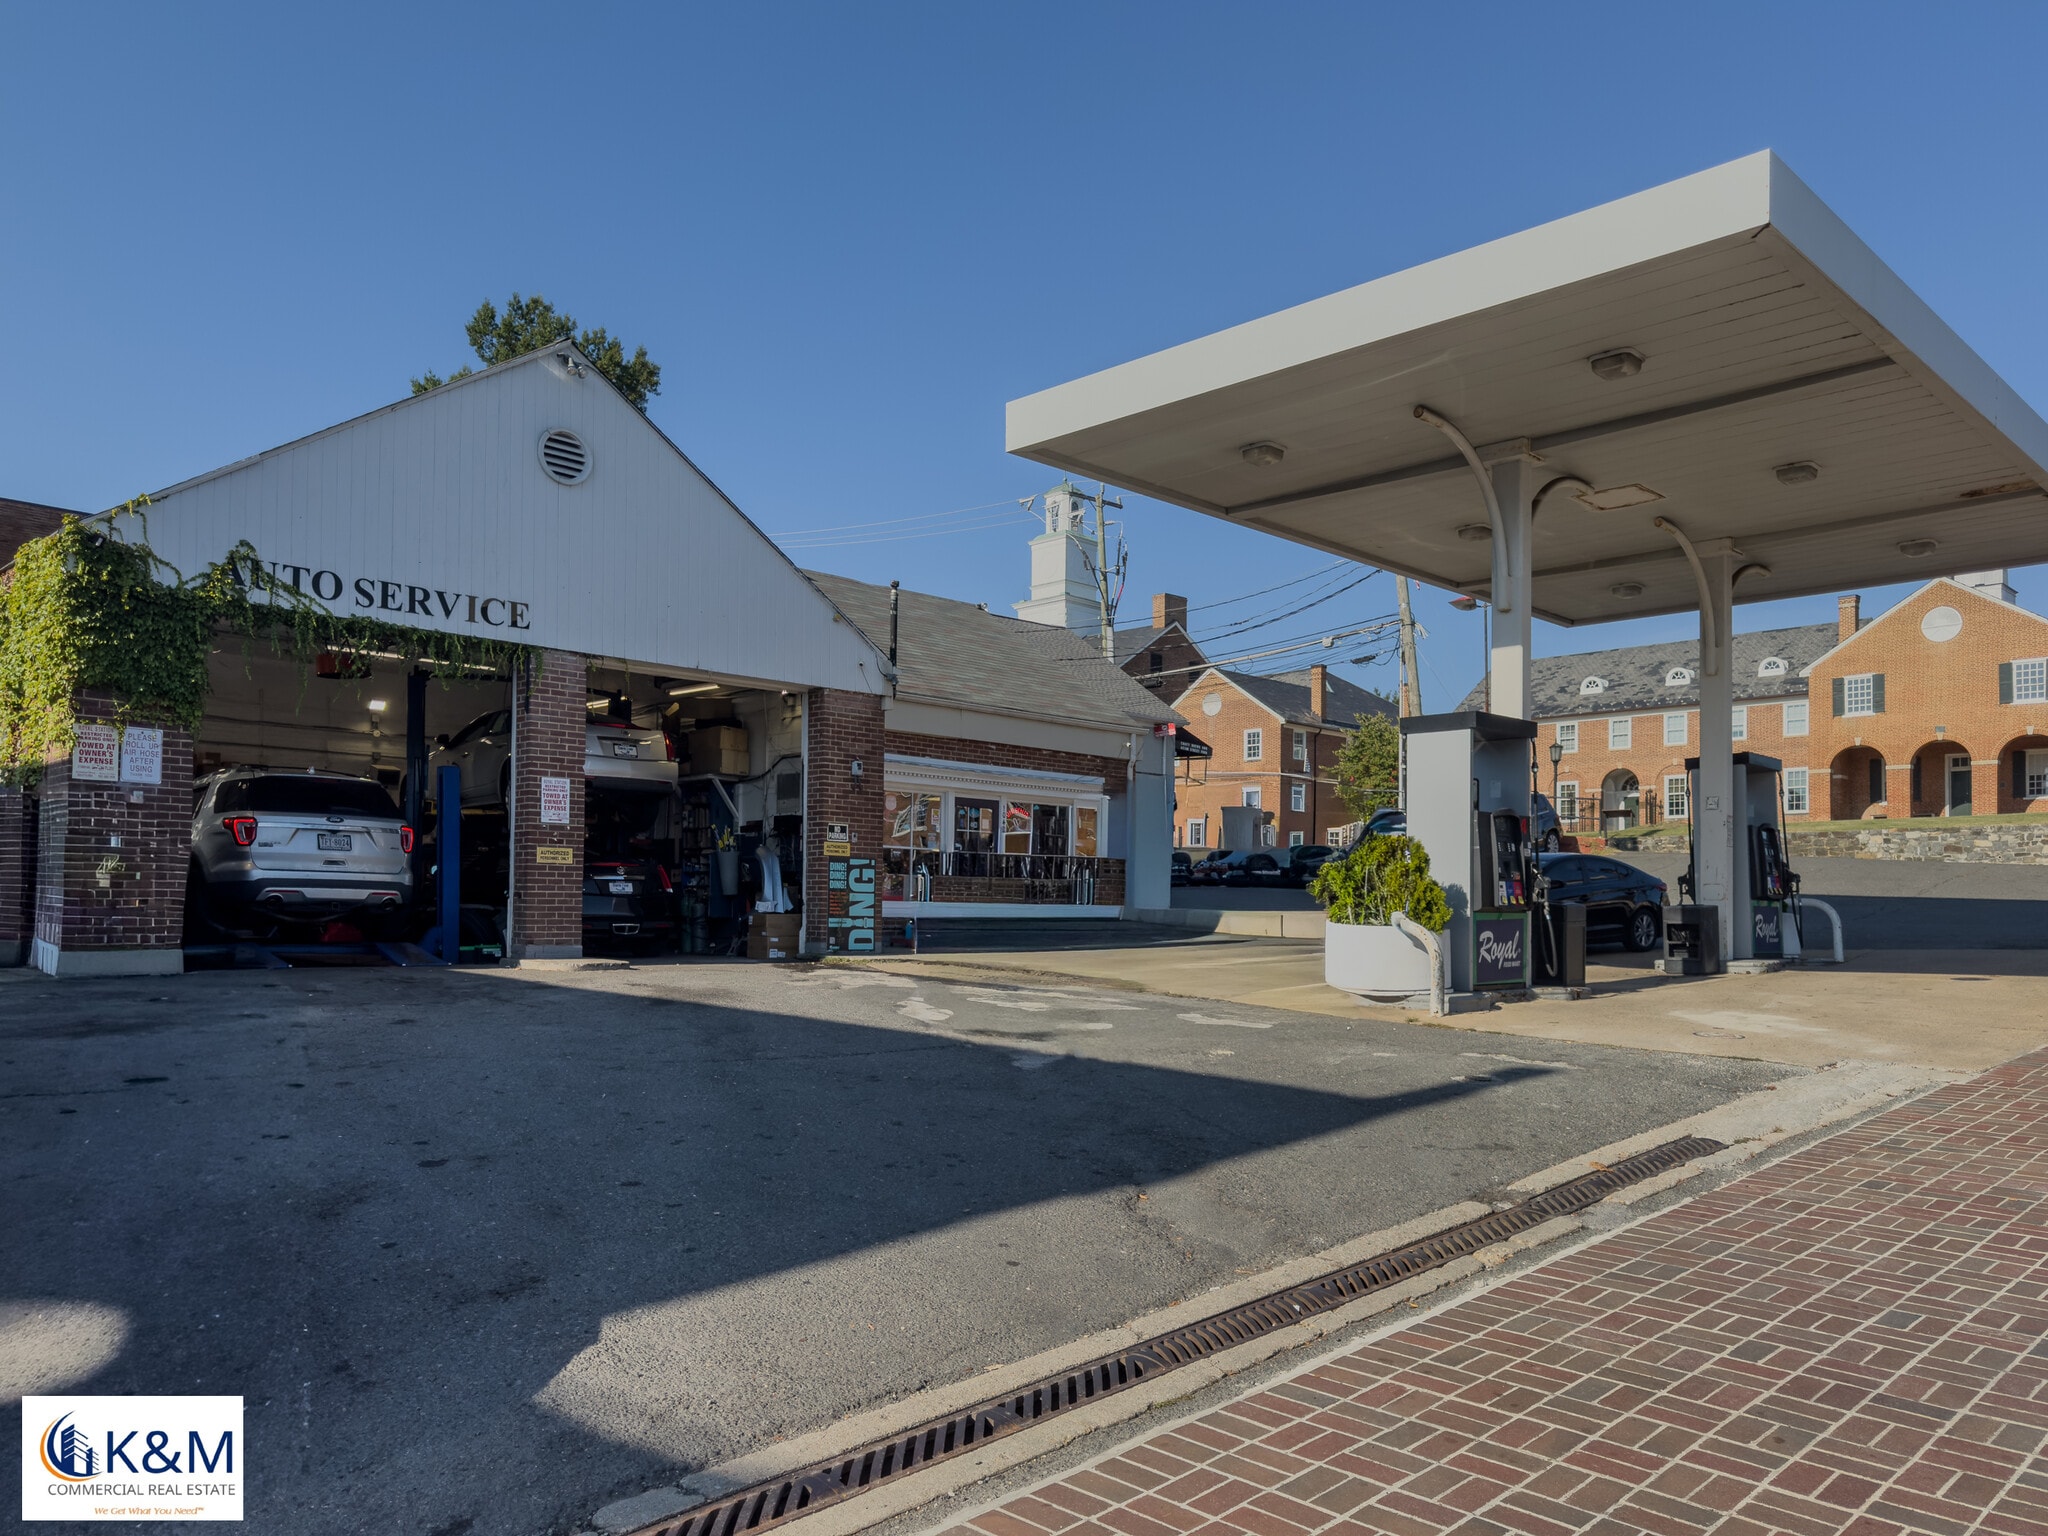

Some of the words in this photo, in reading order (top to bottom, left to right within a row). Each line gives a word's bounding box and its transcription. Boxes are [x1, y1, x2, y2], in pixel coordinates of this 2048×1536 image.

[226, 556, 343, 601] AUTO
[354, 577, 531, 630] SERVICE
[127, 733, 157, 742] PLEASE
[76, 741, 104, 749] TOWED
[106, 743, 116, 751] AT
[125, 741, 145, 749] ROLL
[78, 749, 114, 758] OWNER'S
[124, 748, 137, 756] AIR
[140, 749, 160, 758] HOSE
[78, 756, 114, 765] EXPENSE
[129, 756, 154, 765] AFTER
[129, 764, 153, 773] USING
[829, 862, 847, 871] DING!
[829, 871, 847, 879] DING!
[829, 880, 847, 889] DING!
[847, 858, 875, 951] DING!
[1755, 914, 1777, 943] Royal
[1479, 930, 1519, 970] Royal
